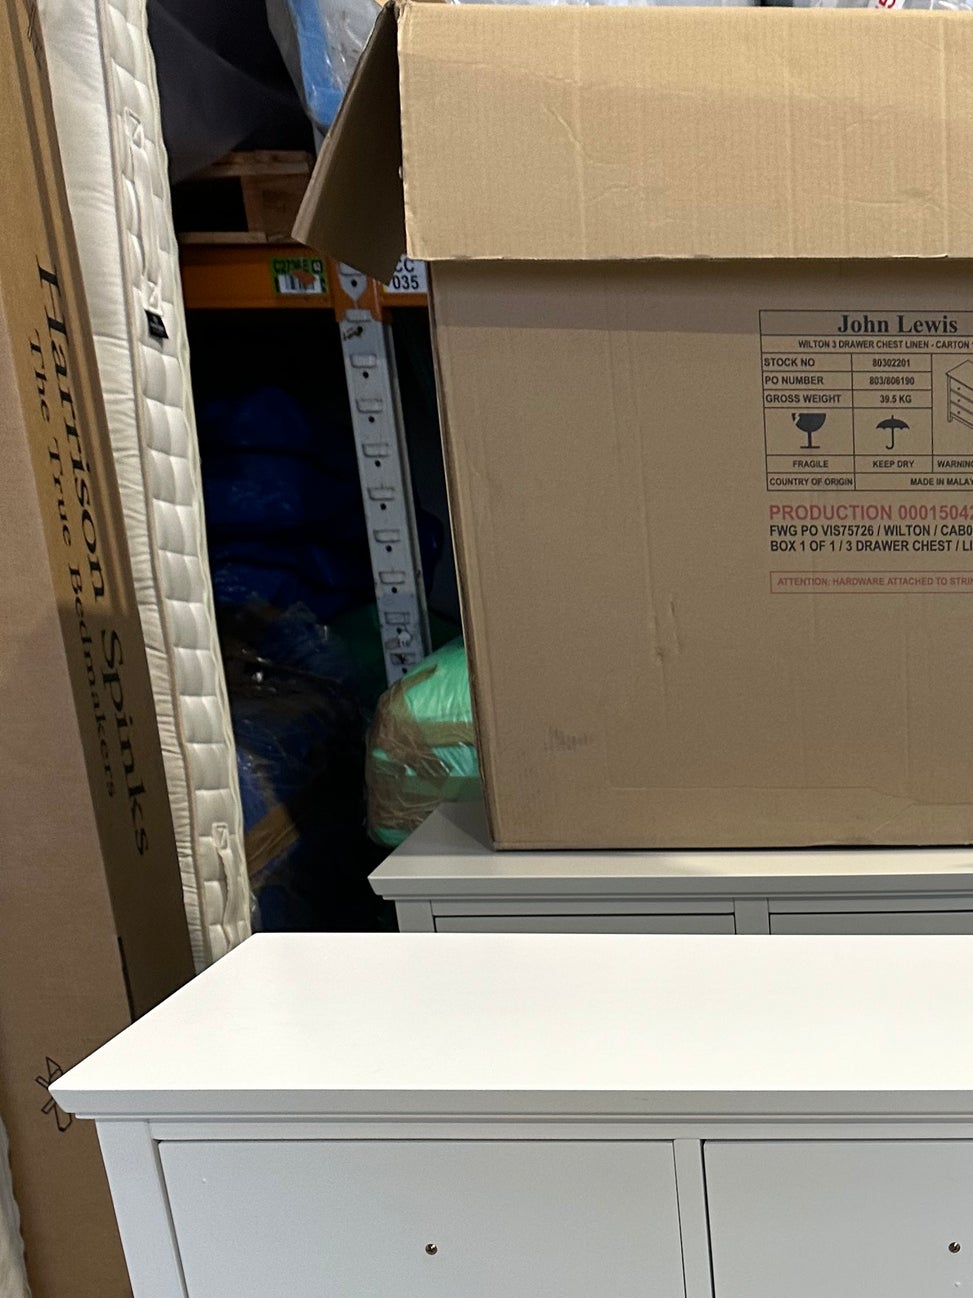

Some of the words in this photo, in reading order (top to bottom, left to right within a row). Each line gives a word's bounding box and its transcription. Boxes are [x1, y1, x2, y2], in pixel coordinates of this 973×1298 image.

[393, 275, 419, 290] 035
[837, 314, 890, 334] John
[896, 314, 959, 334] Lewis
[798, 339, 830, 349] WILTON
[831, 339, 837, 349] 3
[838, 339, 875, 349] DRAWER
[876, 339, 903, 349] CHEST
[904, 339, 929, 349] LINEN
[936, 339, 970, 349] CARTON
[763, 357, 799, 368] STOCK
[800, 357, 816, 368] NO
[872, 358, 911, 367] 80302201
[765, 375, 779, 386] PO
[781, 375, 824, 386] NUMBER
[765, 393, 800, 404] GROSS
[802, 393, 842, 404] WEIGHT
[880, 394, 897, 404] 39.5
[899, 394, 912, 404] KG
[792, 459, 829, 469] FRAGILE
[872, 459, 895, 469] KEEP
[896, 459, 915, 469] DRY
[769, 477, 809, 486] COUNTRY
[811, 477, 822, 486] OF
[824, 477, 854, 486] ORIGIN
[910, 477, 935, 486] MADE
[936, 477, 945, 486] IN
[769, 504, 892, 521] PRODUCTION
[769, 524, 798, 537] FWG
[801, 524, 818, 537] PO
[822, 524, 874, 537] VIS75726
[883, 524, 931, 537] WILTON
[770, 540, 797, 552] BOX
[809, 540, 827, 552] OF
[845, 540, 853, 552] 3
[856, 540, 909, 552] DRAWER
[912, 540, 952, 552] CHEST
[35, 253, 106, 602] Harrison
[101, 628, 150, 857] Spinks
[28, 328, 51, 424] The
[48, 437, 72, 548] True
[67, 561, 115, 799] Bedmakers
[777, 577, 831, 587] ATTENTION:
[832, 577, 885, 587] HARDWARE
[886, 577, 934, 587] ATTACHED
[935, 577, 949, 587] TO
